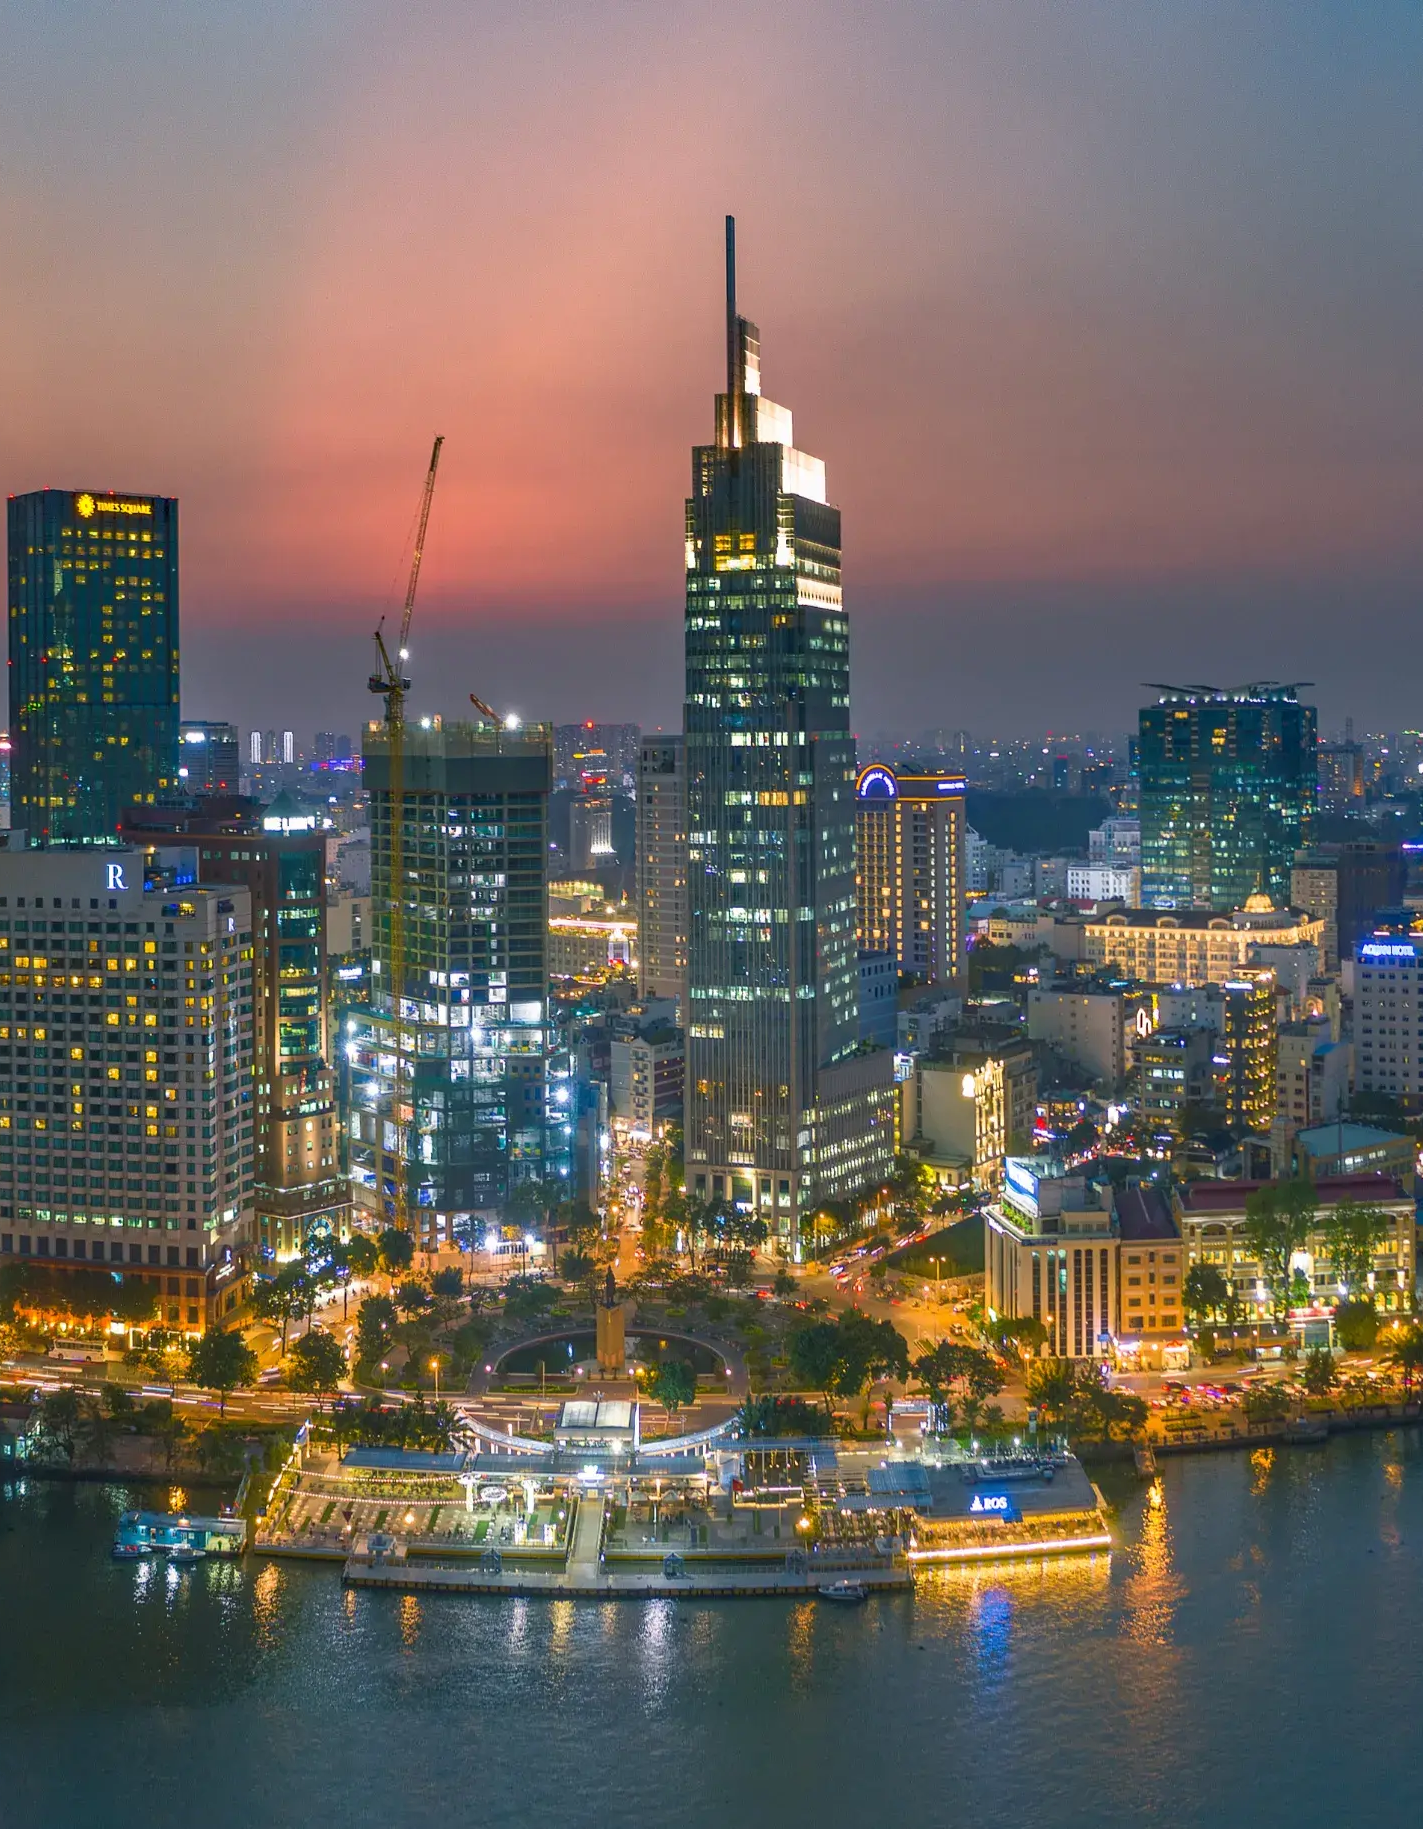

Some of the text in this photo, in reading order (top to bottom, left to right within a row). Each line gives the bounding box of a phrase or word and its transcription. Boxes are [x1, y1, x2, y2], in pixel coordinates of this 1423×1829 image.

[97, 502, 152, 515] TIMES SQUARE
[106, 864, 128, 890] R
[228, 917, 236, 932] R
